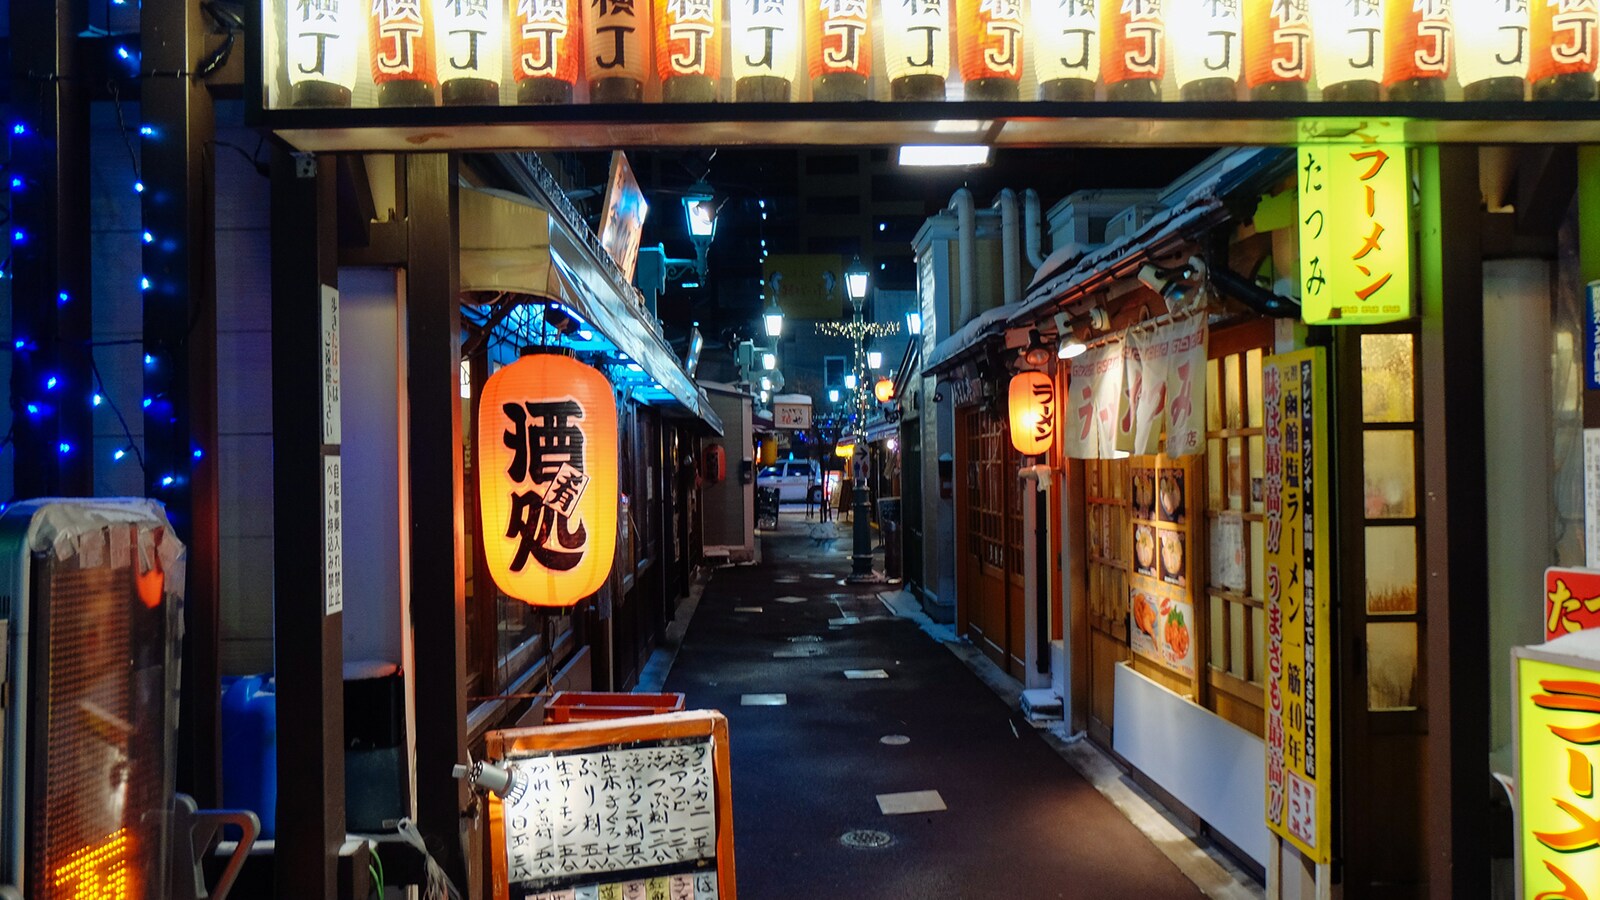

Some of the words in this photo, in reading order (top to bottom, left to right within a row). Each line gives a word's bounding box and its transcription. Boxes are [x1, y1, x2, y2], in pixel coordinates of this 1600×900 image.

[1303, 152, 1326, 296] たつみ
[1349, 146, 1393, 301] ラーメン
[1032, 383, 1054, 442] ラーメン
[333, 463, 341, 605] 自転車乗入れ禁止
[502, 400, 587, 572] 酒処
[549, 470, 583, 512] 肴
[556, 760, 577, 837] 生サーモン
